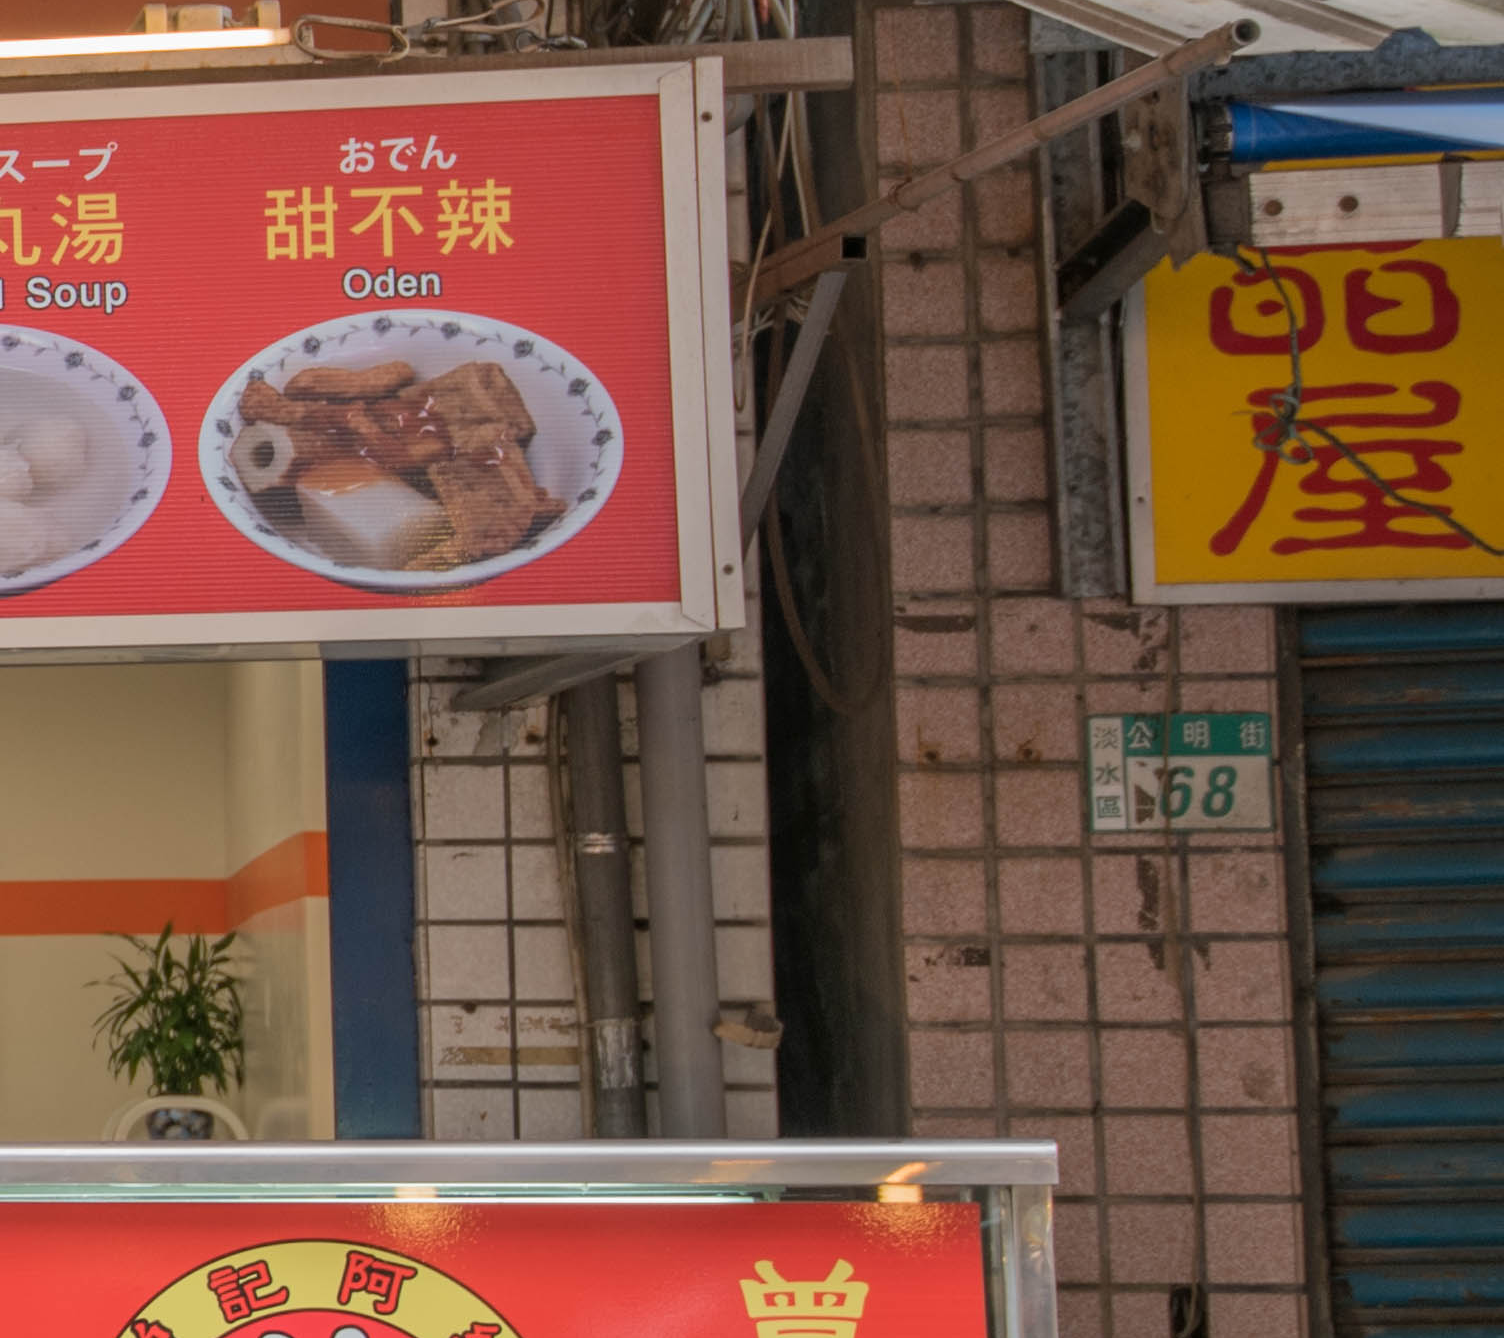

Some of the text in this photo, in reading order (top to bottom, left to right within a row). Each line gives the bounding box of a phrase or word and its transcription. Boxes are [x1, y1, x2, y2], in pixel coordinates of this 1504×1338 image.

[338, 134, 458, 175] おでん
[264, 179, 515, 261] 甜不辣
[24, 274, 130, 315] Soup
[341, 267, 443, 301] Oden
[1127, 720, 1266, 750] 公明街
[1094, 726, 1122, 819] 淡水區
[1160, 765, 1237, 819] 68
